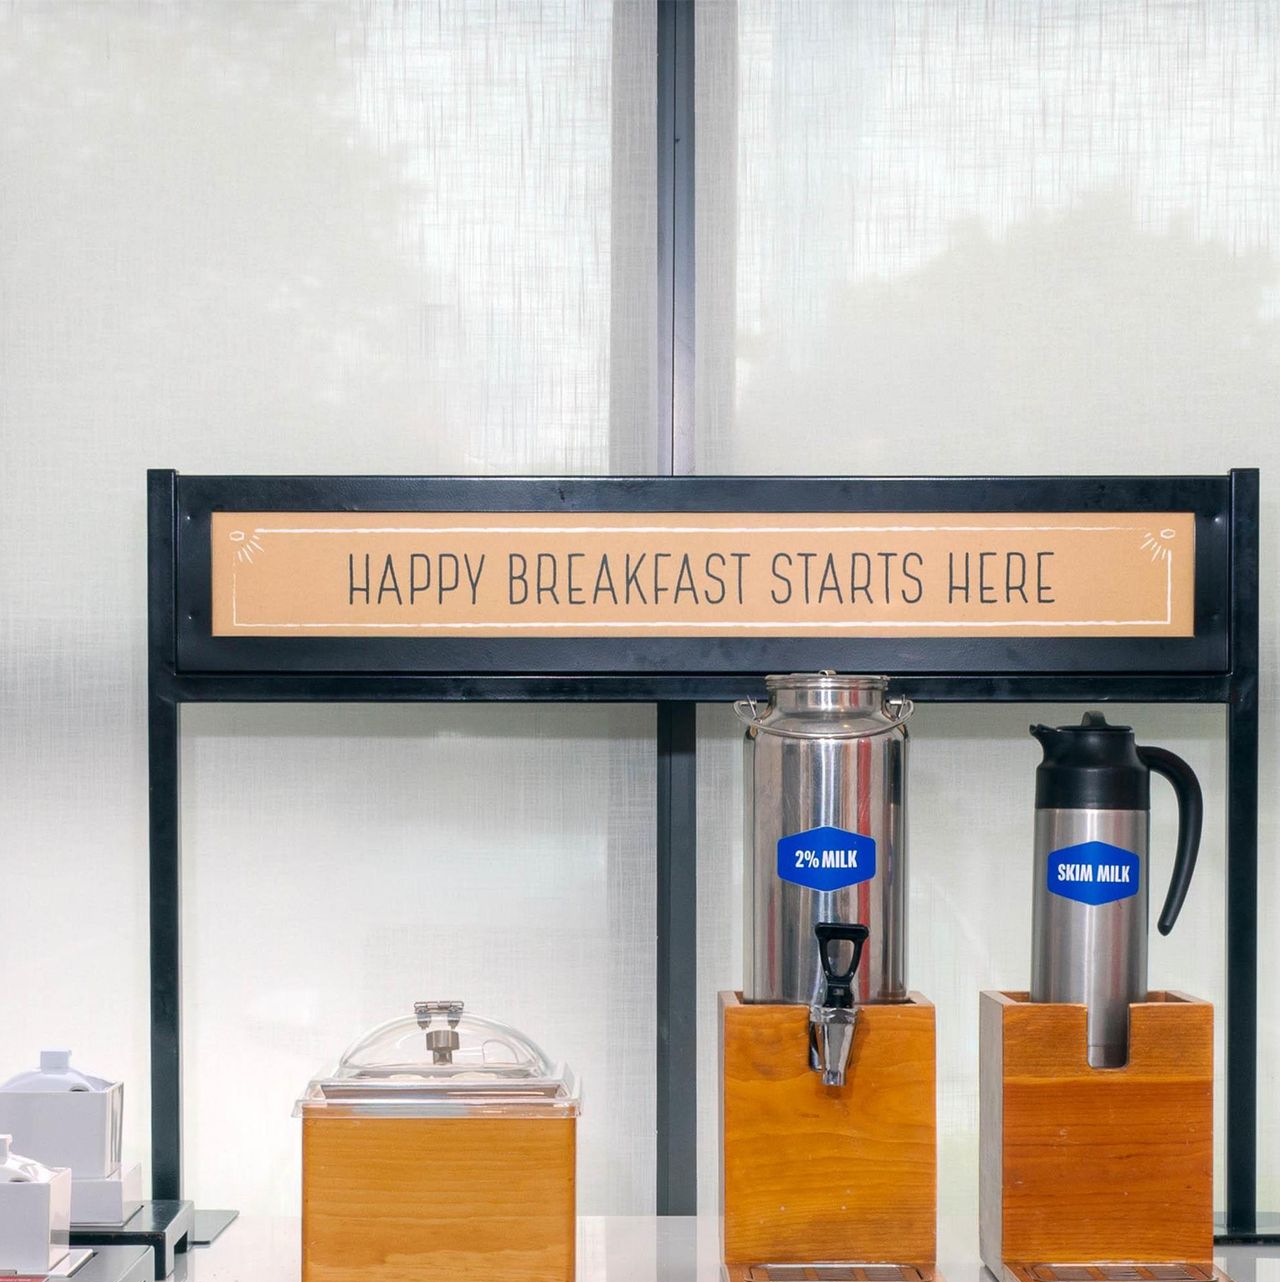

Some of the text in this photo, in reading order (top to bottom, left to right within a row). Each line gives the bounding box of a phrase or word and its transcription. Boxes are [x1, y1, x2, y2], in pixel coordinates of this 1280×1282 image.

[348, 551, 1056, 606] HAPPY BREAKFAST STARTS HERE
[794, 848, 858, 869] 2% MILK
[1057, 863, 1131, 884] SKIM MILK
